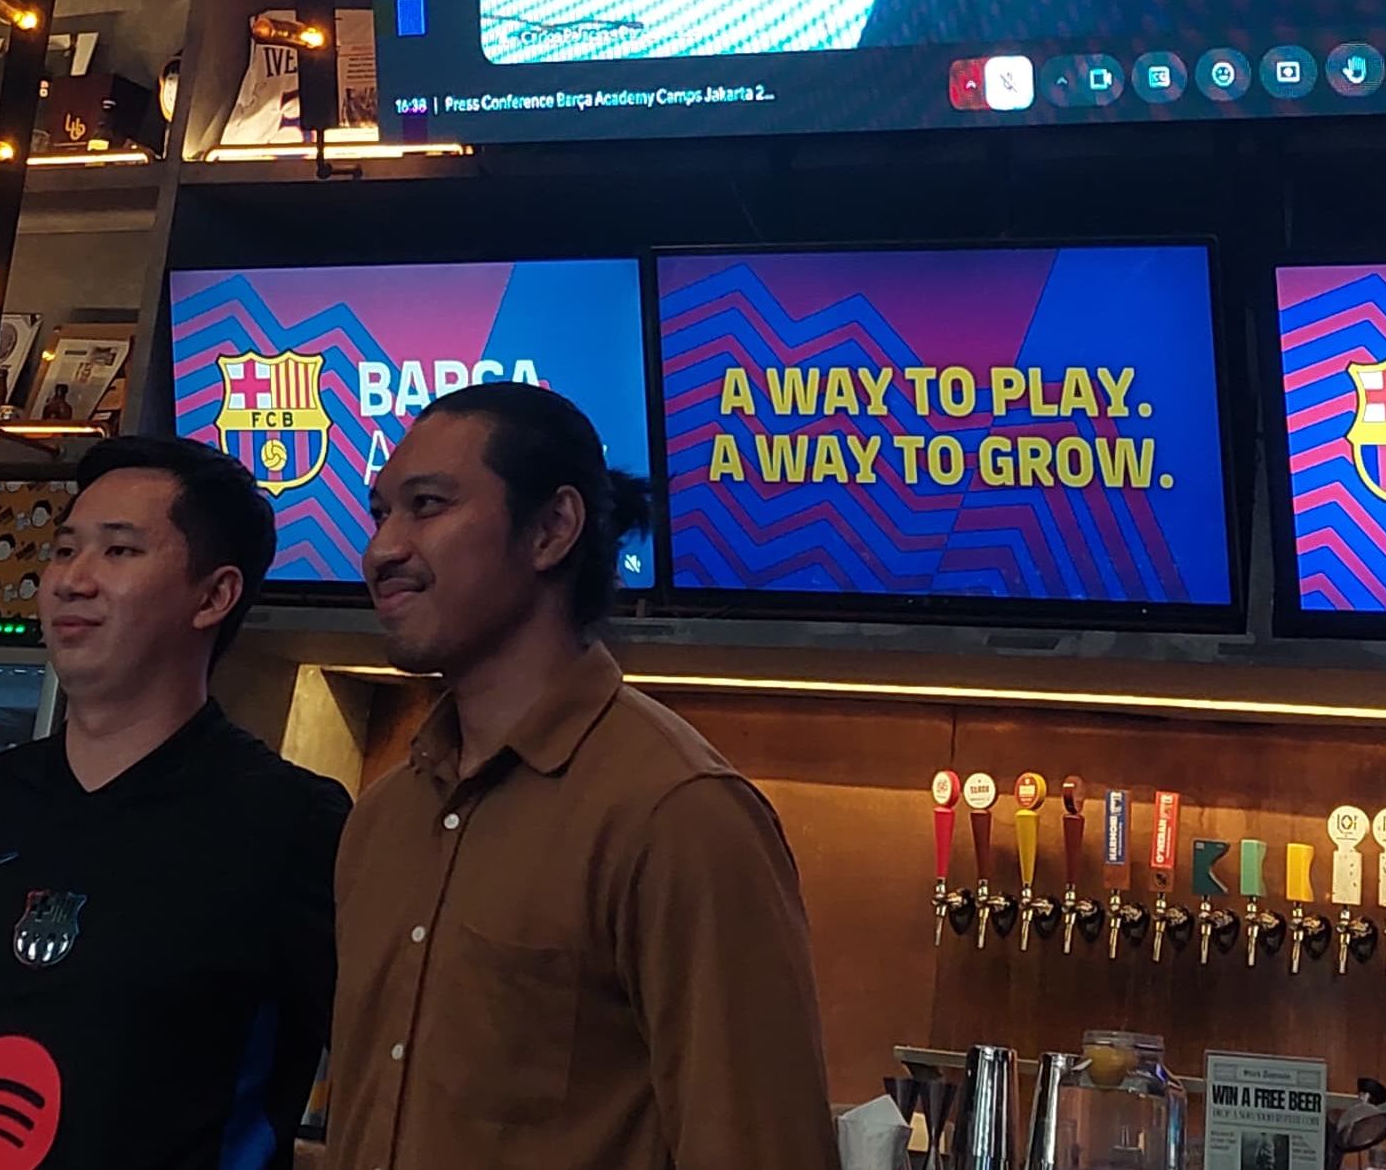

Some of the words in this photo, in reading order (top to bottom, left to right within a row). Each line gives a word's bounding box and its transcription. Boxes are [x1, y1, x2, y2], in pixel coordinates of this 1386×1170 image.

[264, 47, 298, 78] IVE
[445, 96, 480, 113] Press
[481, 92, 554, 111] Conference
[594, 89, 656, 111] Academy
[656, 88, 703, 106] Camps
[704, 85, 755, 103] Jakarta
[720, 367, 756, 415] A
[765, 367, 894, 416] WAY
[905, 367, 977, 417] TO
[989, 367, 1154, 417] PLAY.
[709, 435, 745, 482] A
[755, 435, 884, 484] WAY
[893, 435, 966, 486] TO
[978, 437, 1175, 489] GROW.
[1212, 1084, 1238, 1107] WIN
[1241, 1086, 1251, 1108] A
[1254, 1087, 1286, 1110] FREE
[1288, 1090, 1322, 1114] BEER
